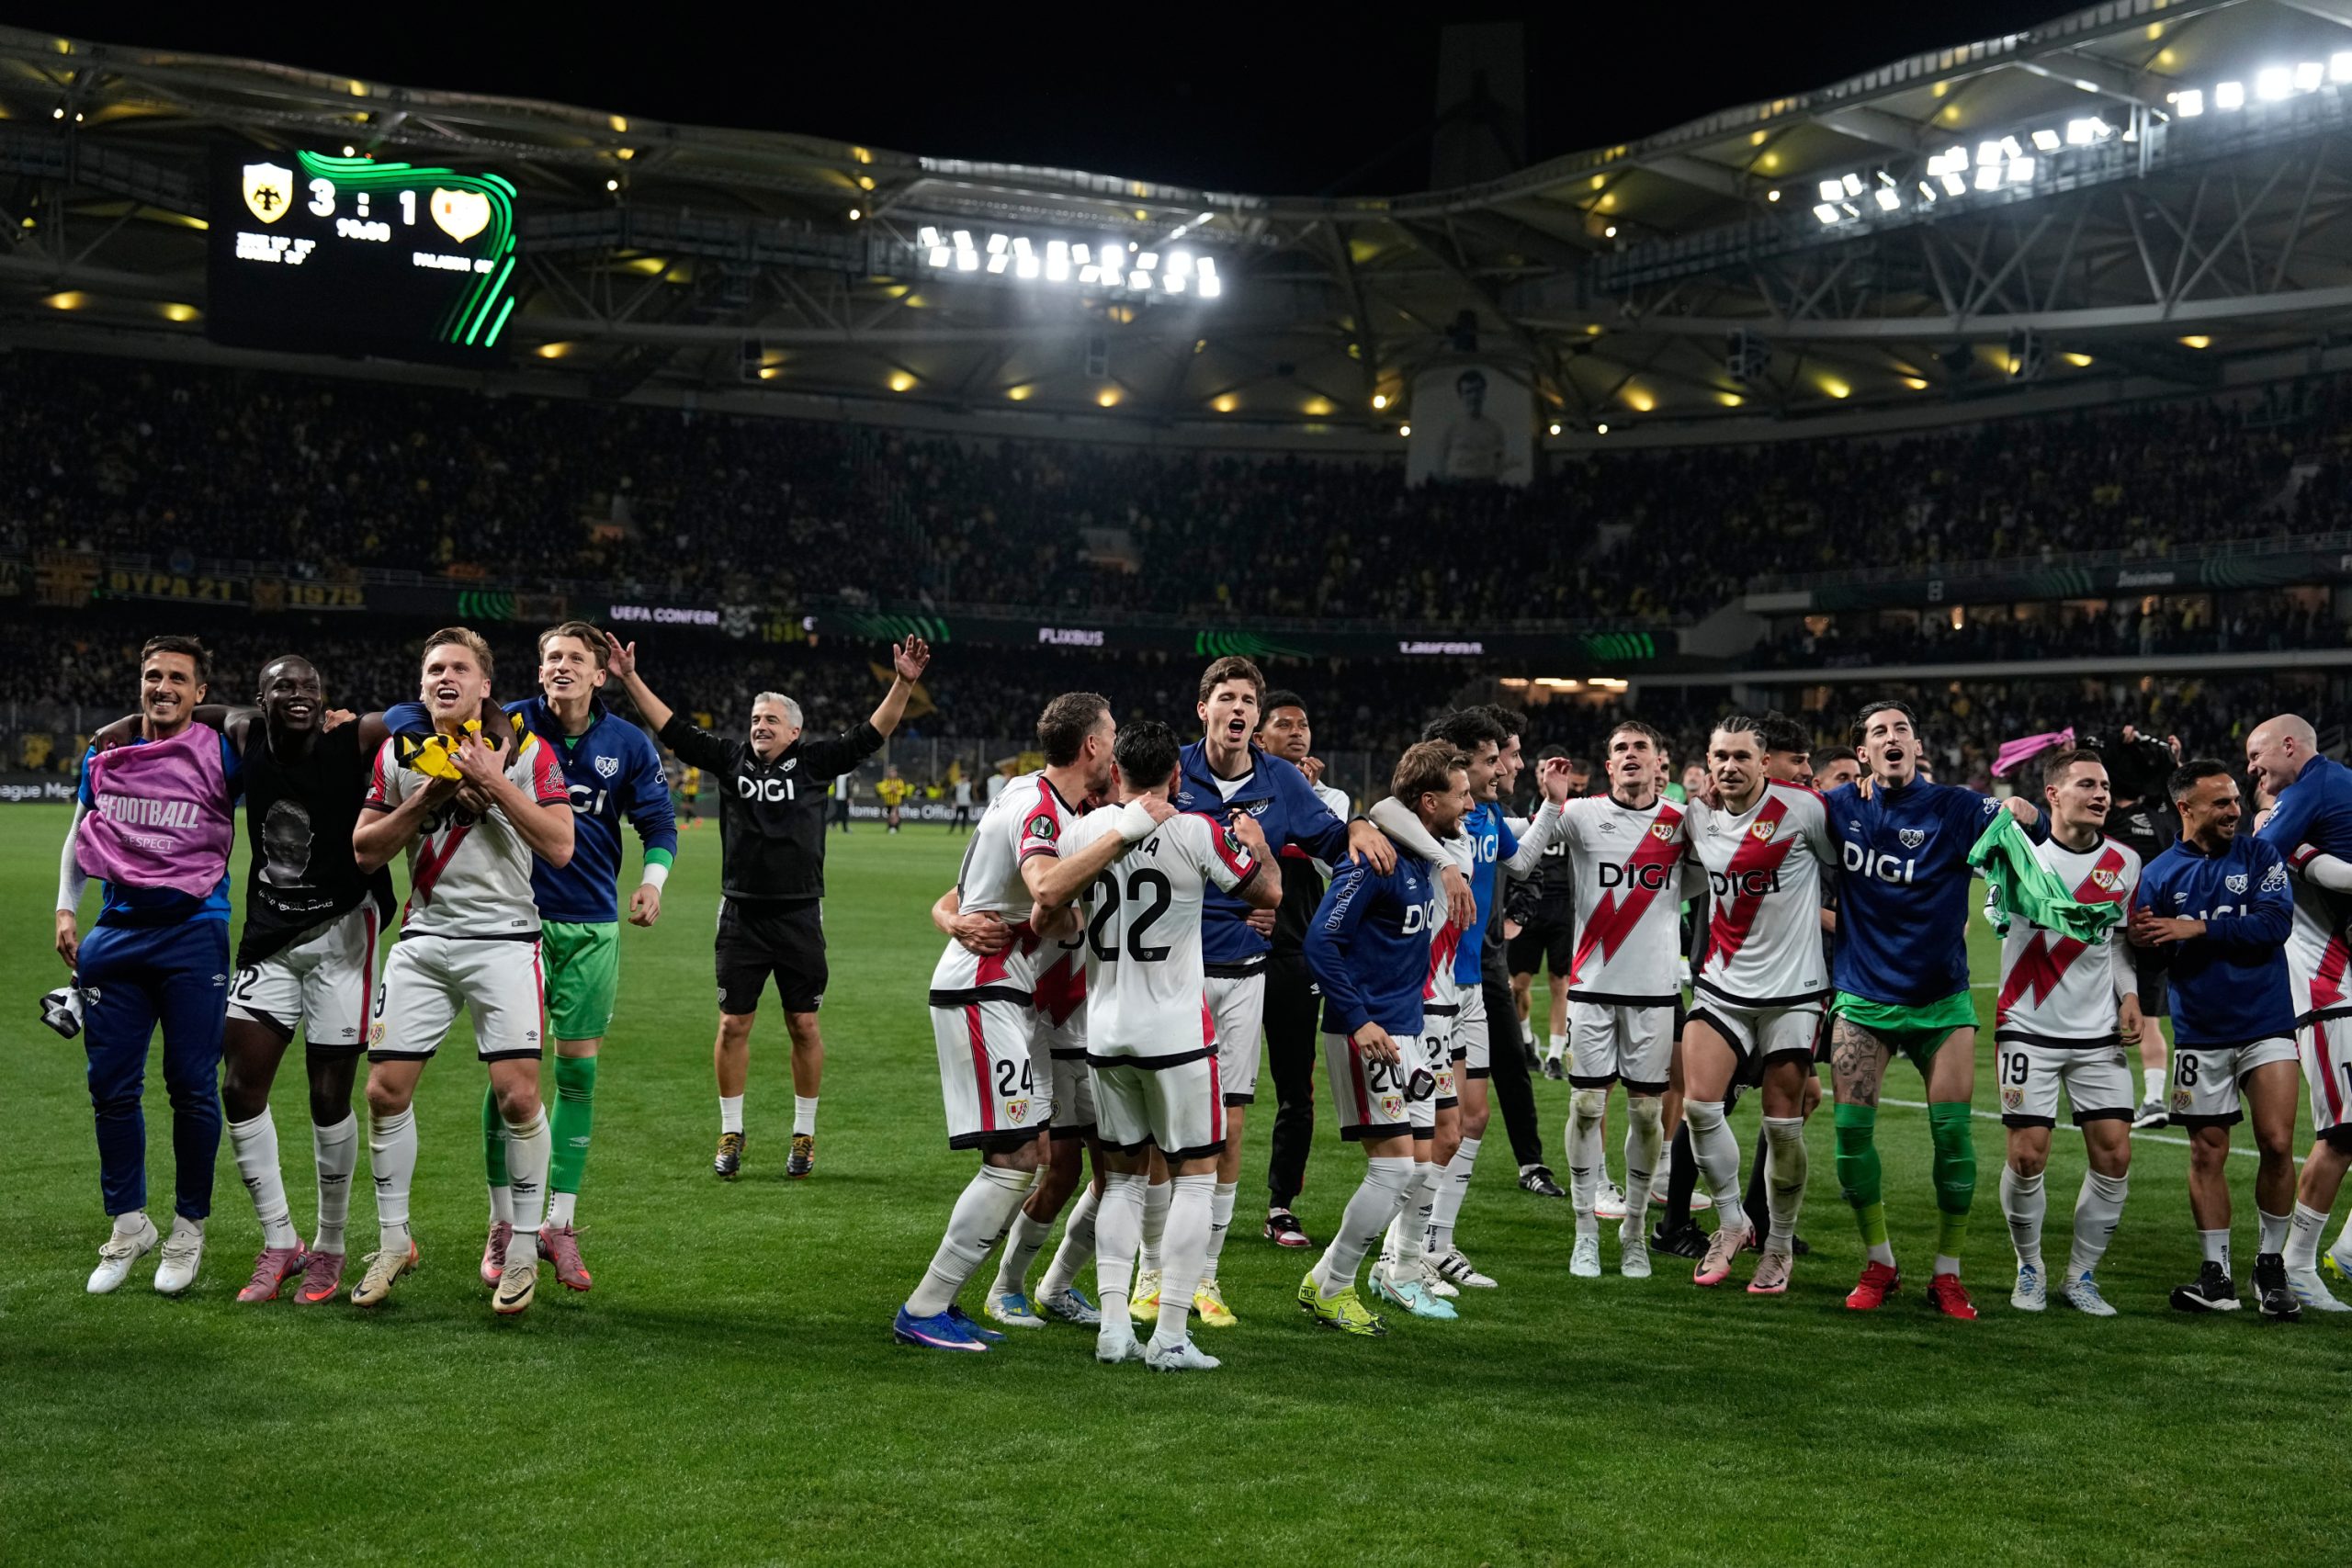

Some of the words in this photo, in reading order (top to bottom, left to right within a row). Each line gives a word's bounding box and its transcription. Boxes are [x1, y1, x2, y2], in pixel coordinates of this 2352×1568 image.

[308, 178, 335, 217] 3
[400, 190, 415, 225] 1
[610, 605, 652, 622] UEFA
[0, 785, 41, 802] ague
[738, 775, 795, 802] DIGI
[1599, 863, 1672, 890] DIGI
[1843, 840, 1916, 885] DIGI
[1325, 868, 1364, 931] umbro
[1709, 869, 1781, 897] DIGI
[1083, 868, 1171, 962] 22
[996, 1059, 1034, 1097] 24
[2001, 1053, 2030, 1086] 19
[2174, 1054, 2199, 1087] 18
